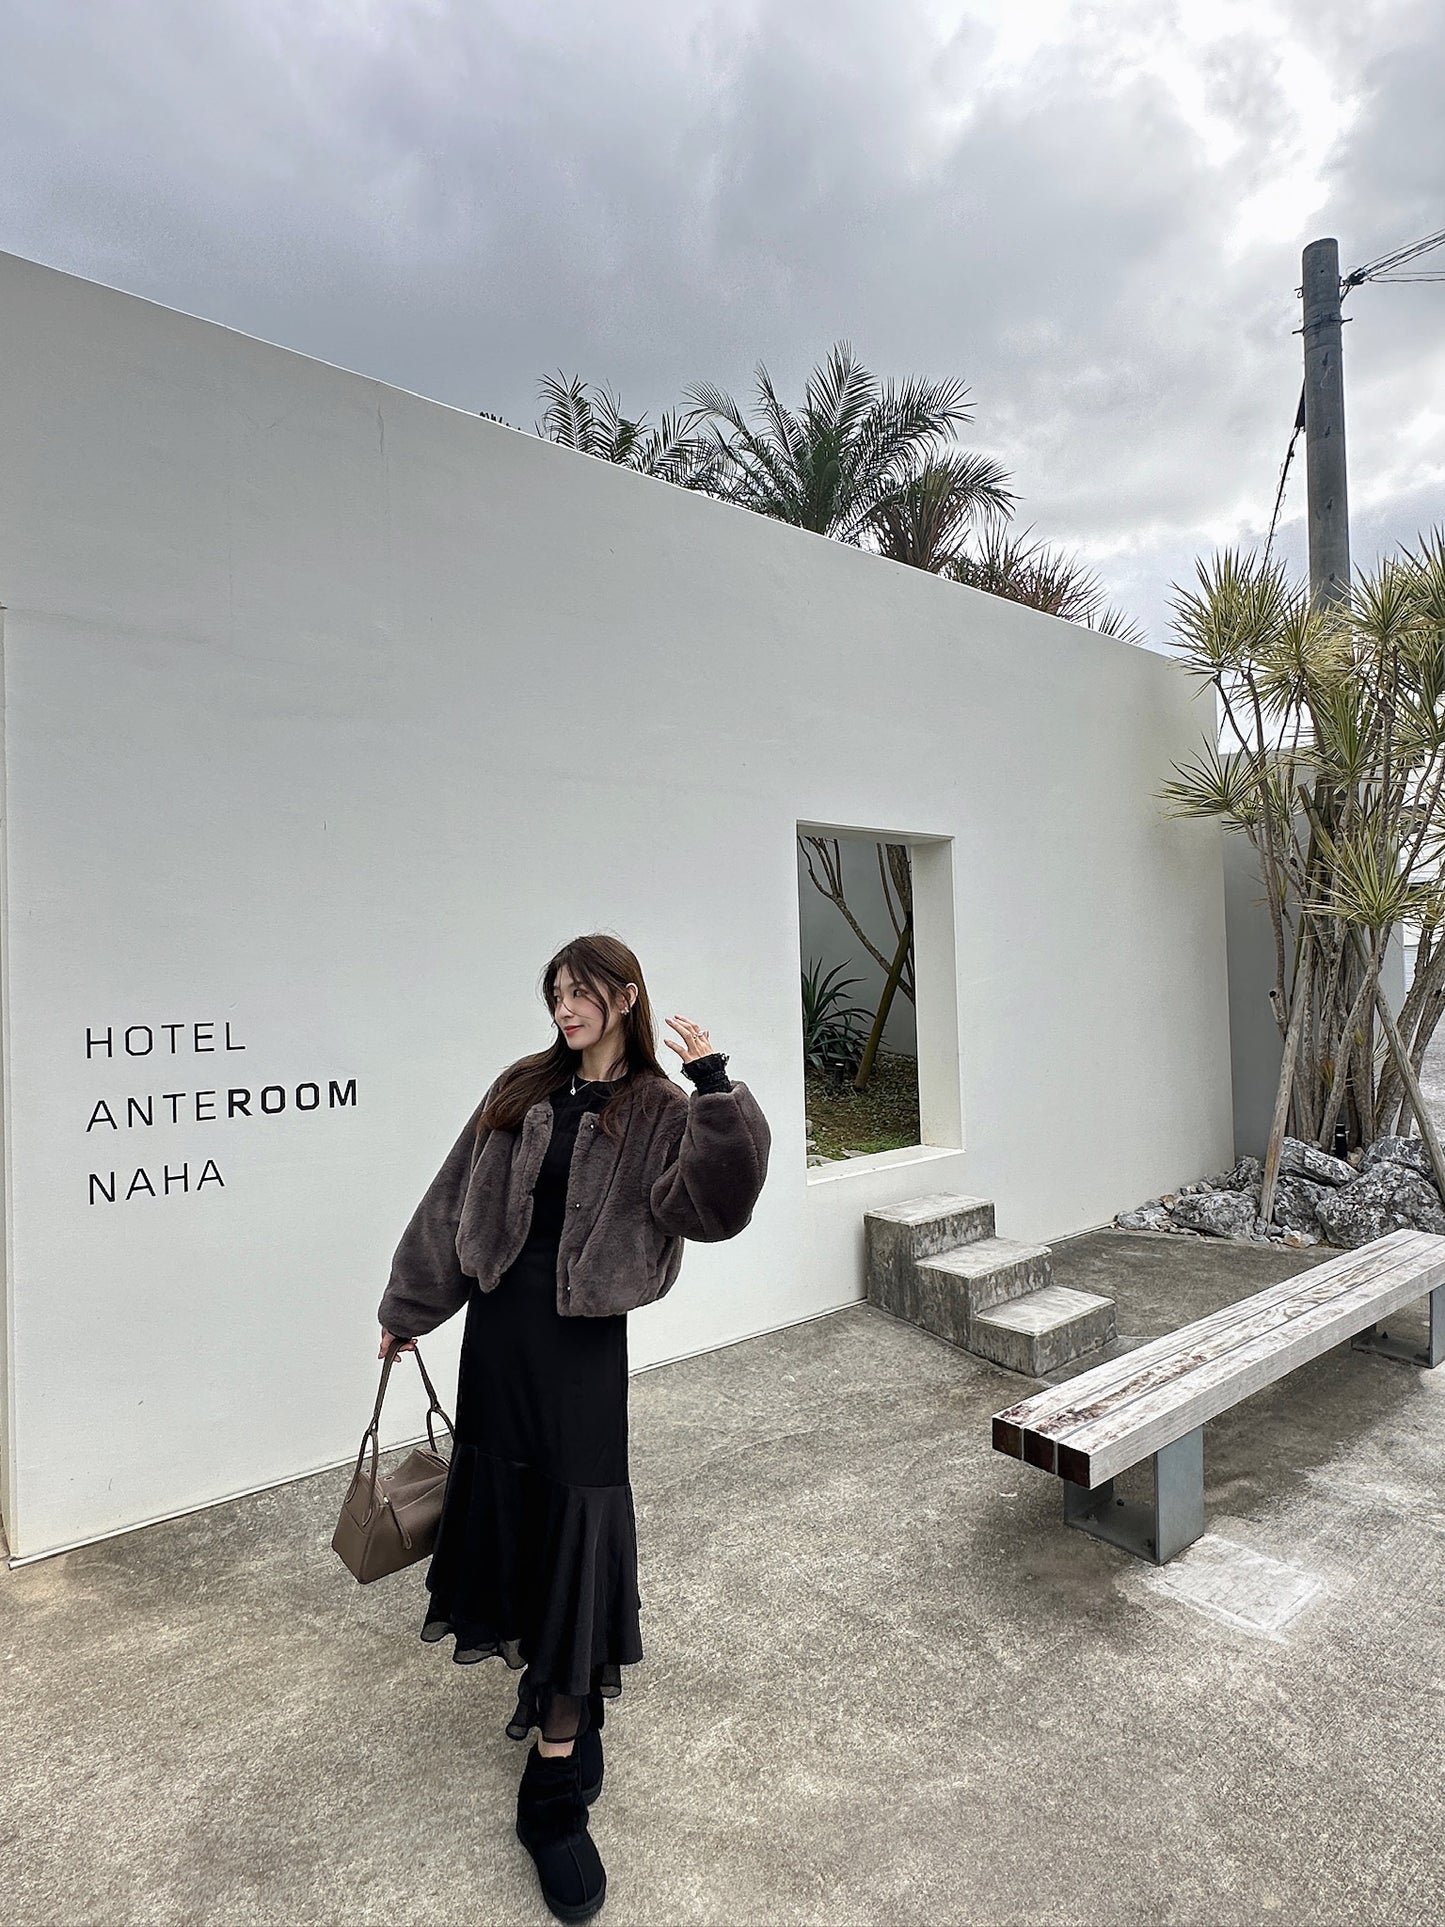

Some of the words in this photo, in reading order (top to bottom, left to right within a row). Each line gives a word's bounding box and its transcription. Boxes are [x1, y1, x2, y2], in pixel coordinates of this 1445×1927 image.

[86, 1022, 246, 1059] HOTEL
[86, 1079, 357, 1133] ANTEROOM
[89, 1159, 225, 1205] NAHA
